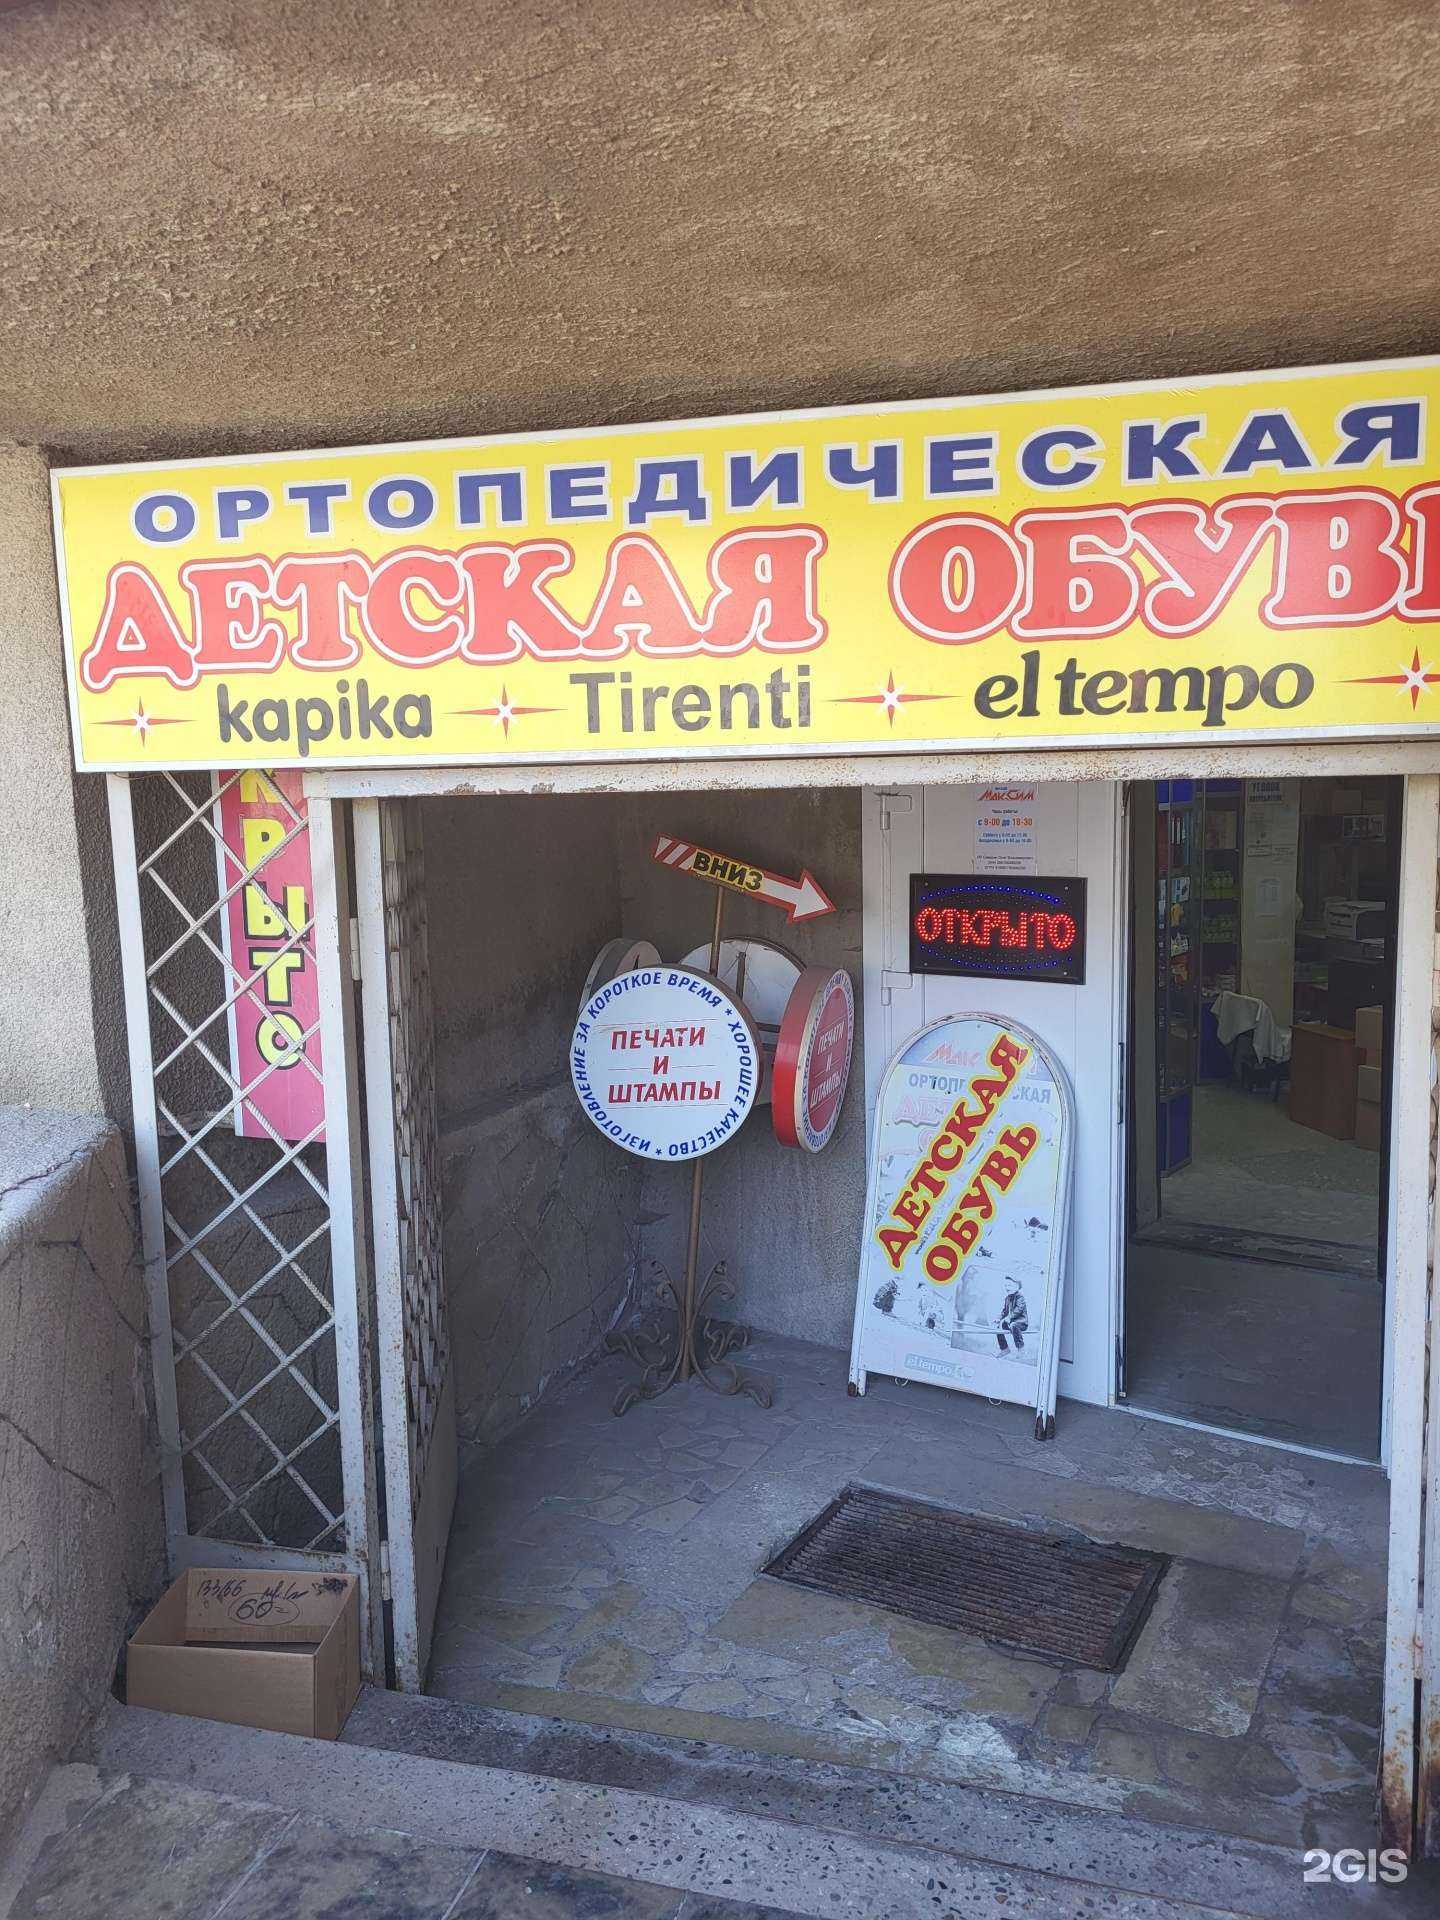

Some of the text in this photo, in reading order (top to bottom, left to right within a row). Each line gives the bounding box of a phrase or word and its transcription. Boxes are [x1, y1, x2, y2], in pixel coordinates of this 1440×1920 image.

[133, 402, 1421, 545] ОРТОПЕДИЧЕСКАЯ
[82, 525, 827, 693] ДЕТСКАЯ
[216, 678, 433, 758] kapika
[569, 664, 812, 734] Tirenti
[974, 650, 1314, 726] el tempo
[692, 850, 764, 892] ВНИЗ
[915, 907, 1077, 950] ОТКРЫТО
[573, 972, 723, 1152] ИЗГОТОВЛЕНИЕ ЗА КОРОТКОЕ ВРЕМЯ
[611, 1027, 706, 1051] ПЕЧАТИ
[652, 1055, 670, 1076] И
[608, 1080, 721, 1104] ШТАМПЫ
[668, 1020, 753, 1157] ХОРОШЕЕ КАЧЕСТВО
[875, 1033, 1031, 1270] ДЕТСКАЯ
[924, 1124, 1039, 1284] ОБУВЬ
